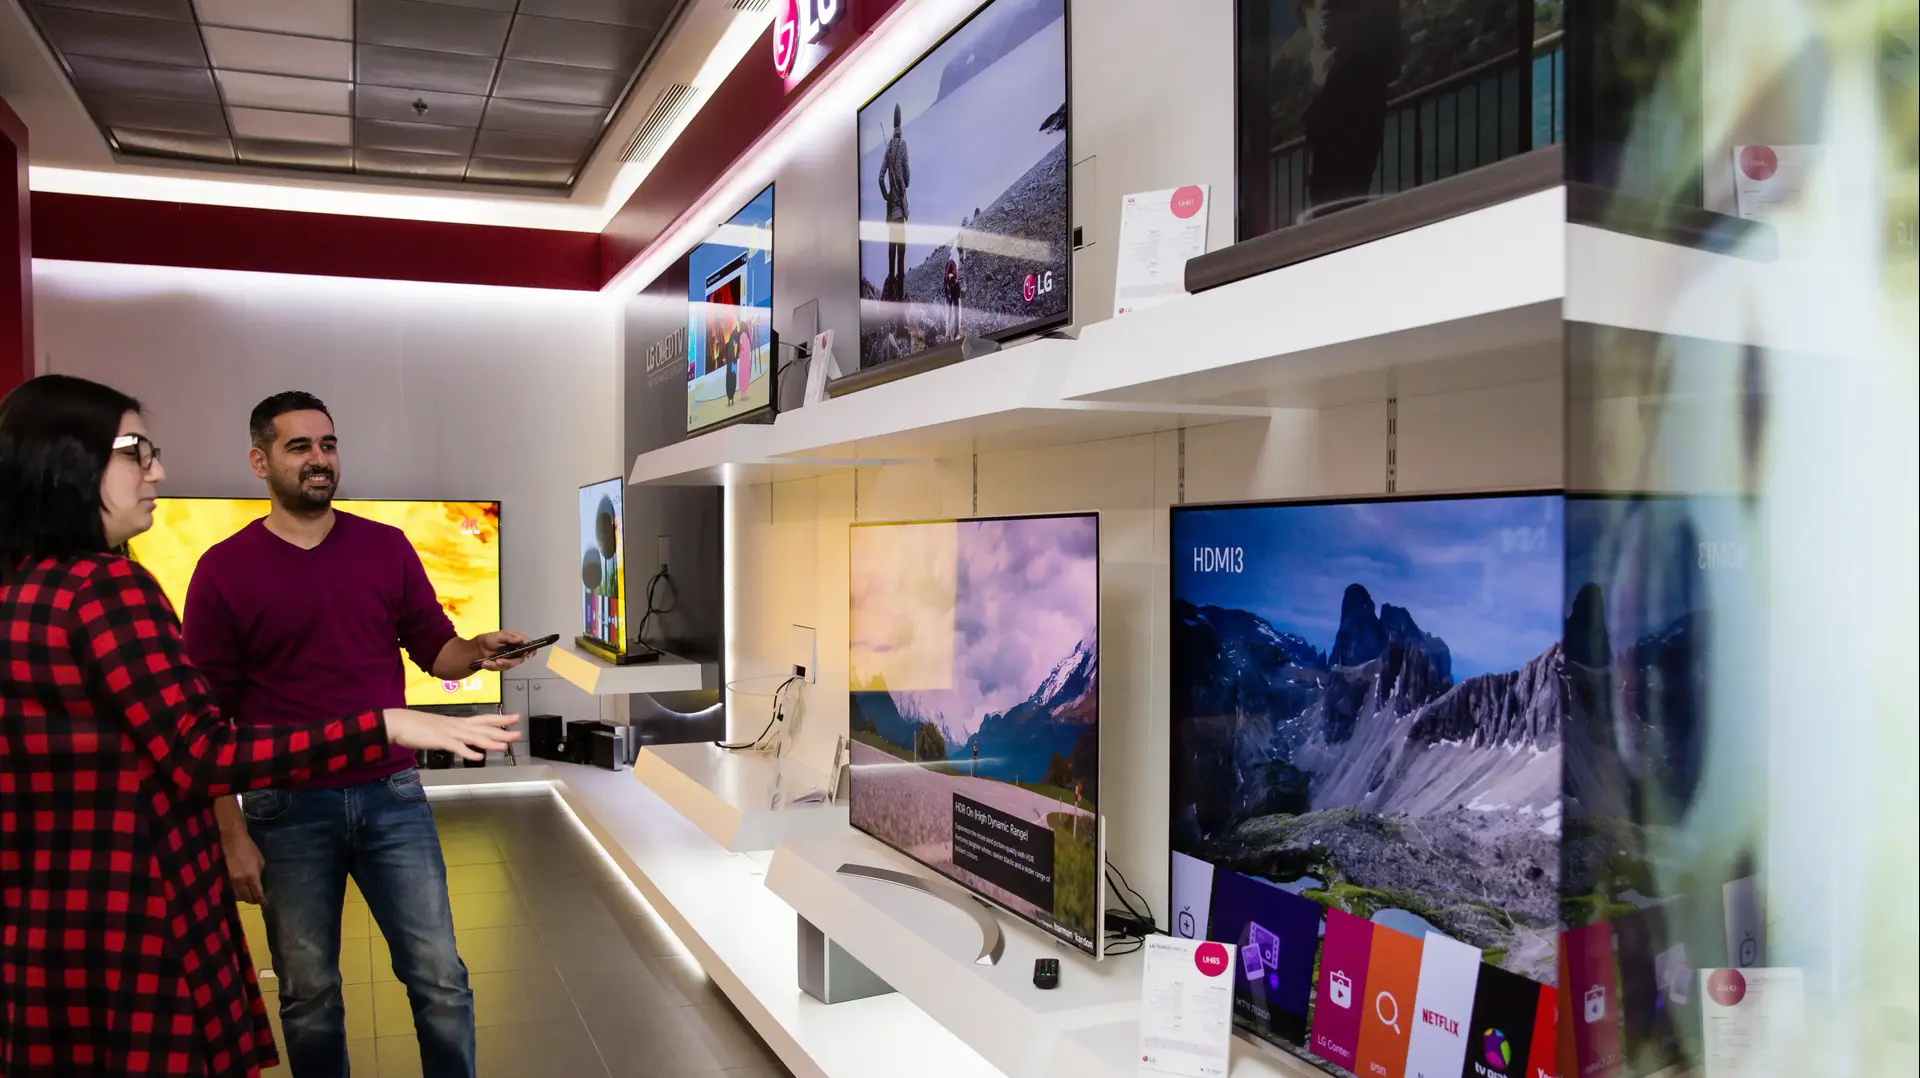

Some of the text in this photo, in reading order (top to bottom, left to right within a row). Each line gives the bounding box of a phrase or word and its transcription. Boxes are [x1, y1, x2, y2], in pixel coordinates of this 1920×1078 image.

[1037, 270, 1053, 295] LG
[646, 346, 655, 373] LG
[460, 517, 480, 530] 4K
[1193, 546, 1244, 574] HDMI3
[955, 801, 966, 815] HDR
[966, 806, 974, 818] On
[987, 814, 1010, 833] Dynamic
[1034, 871, 1046, 882] range
[1422, 1007, 1460, 1038] NETFLIX
[1317, 1034, 1327, 1048] LG
